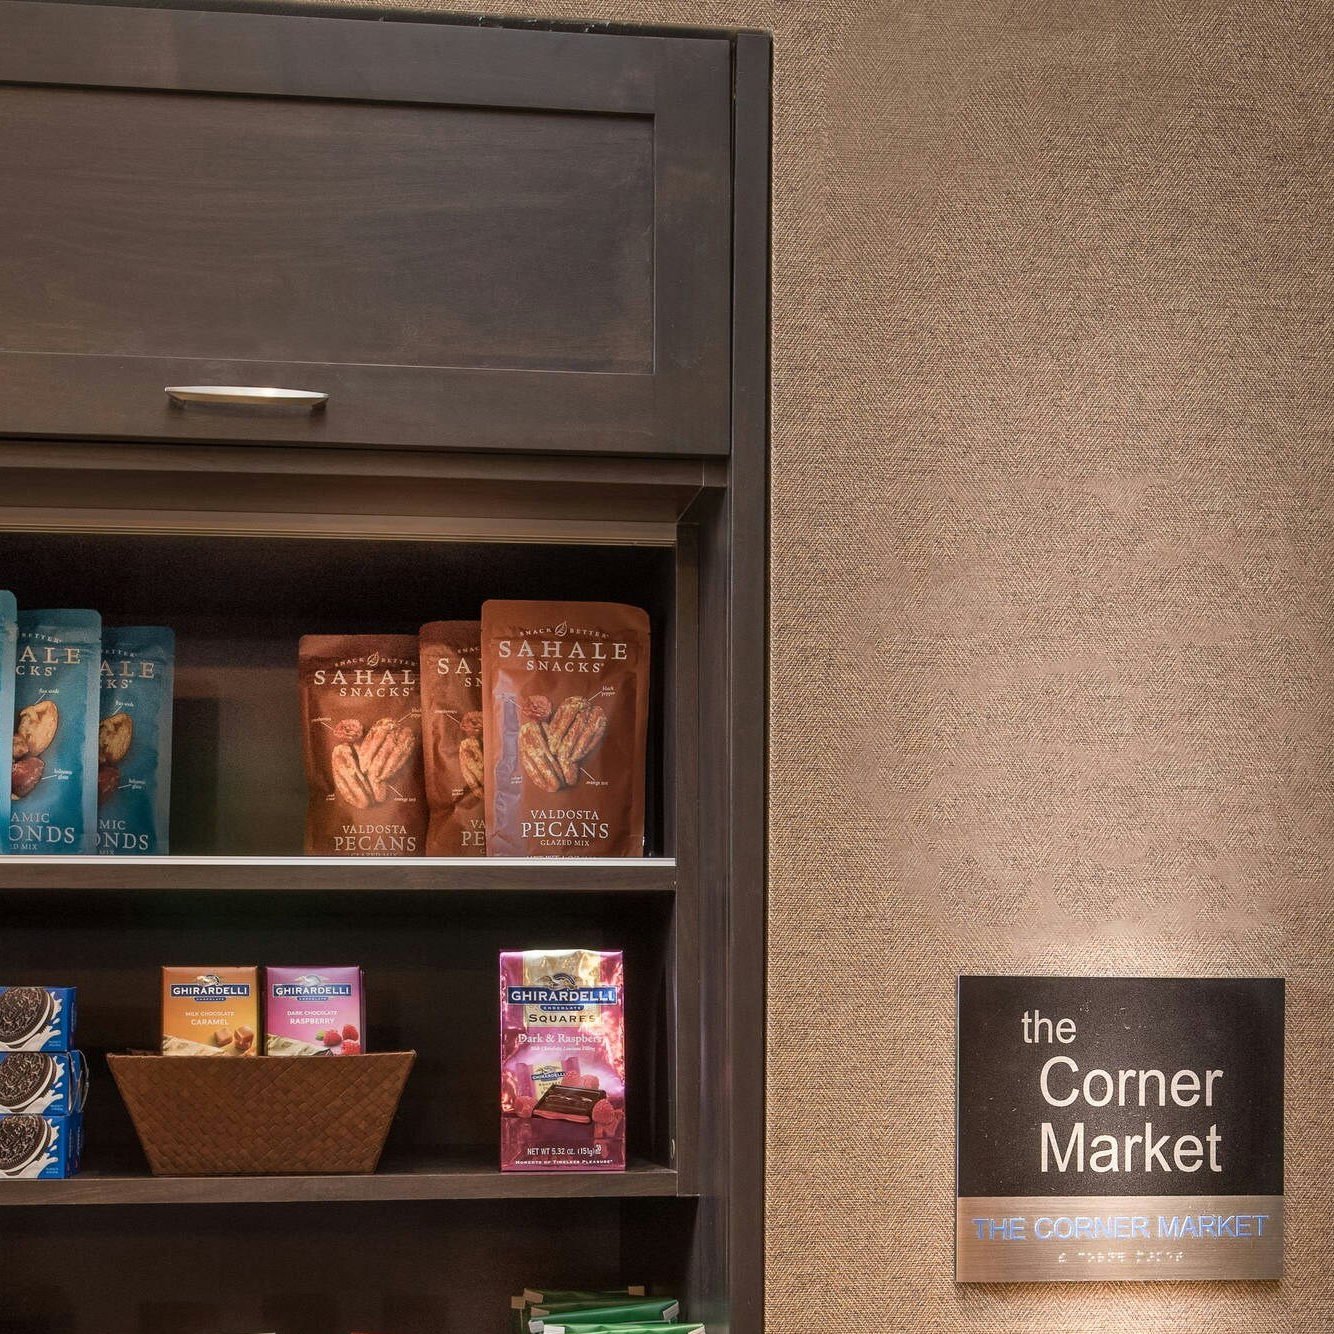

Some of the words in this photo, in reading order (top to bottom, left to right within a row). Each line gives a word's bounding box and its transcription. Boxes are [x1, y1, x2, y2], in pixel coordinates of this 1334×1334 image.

[498, 640, 628, 661] SAHALE
[526, 660, 604, 673] SNACKS
[339, 687, 412, 697] SNACKS
[530, 809, 599, 820] VALDOSTA
[342, 825, 407, 834] VALDOSTA
[521, 822, 609, 839] PECANS
[333, 836, 416, 851] PECANS
[173, 986, 248, 996] GHIRARDELLI
[275, 986, 350, 996] GHIRARDELLI
[511, 990, 615, 1002] GHIRARDELLI
[190, 1018, 229, 1026] CARAMEL
[528, 1013, 596, 1024] SQUARES
[1021, 1009, 1077, 1044] the
[1039, 1055, 1224, 1108] Corner
[1040, 1122, 1223, 1174] Market
[973, 1217, 1025, 1241] THE
[1034, 1216, 1150, 1240] CORNER
[1158, 1214, 1269, 1240] MARKET
